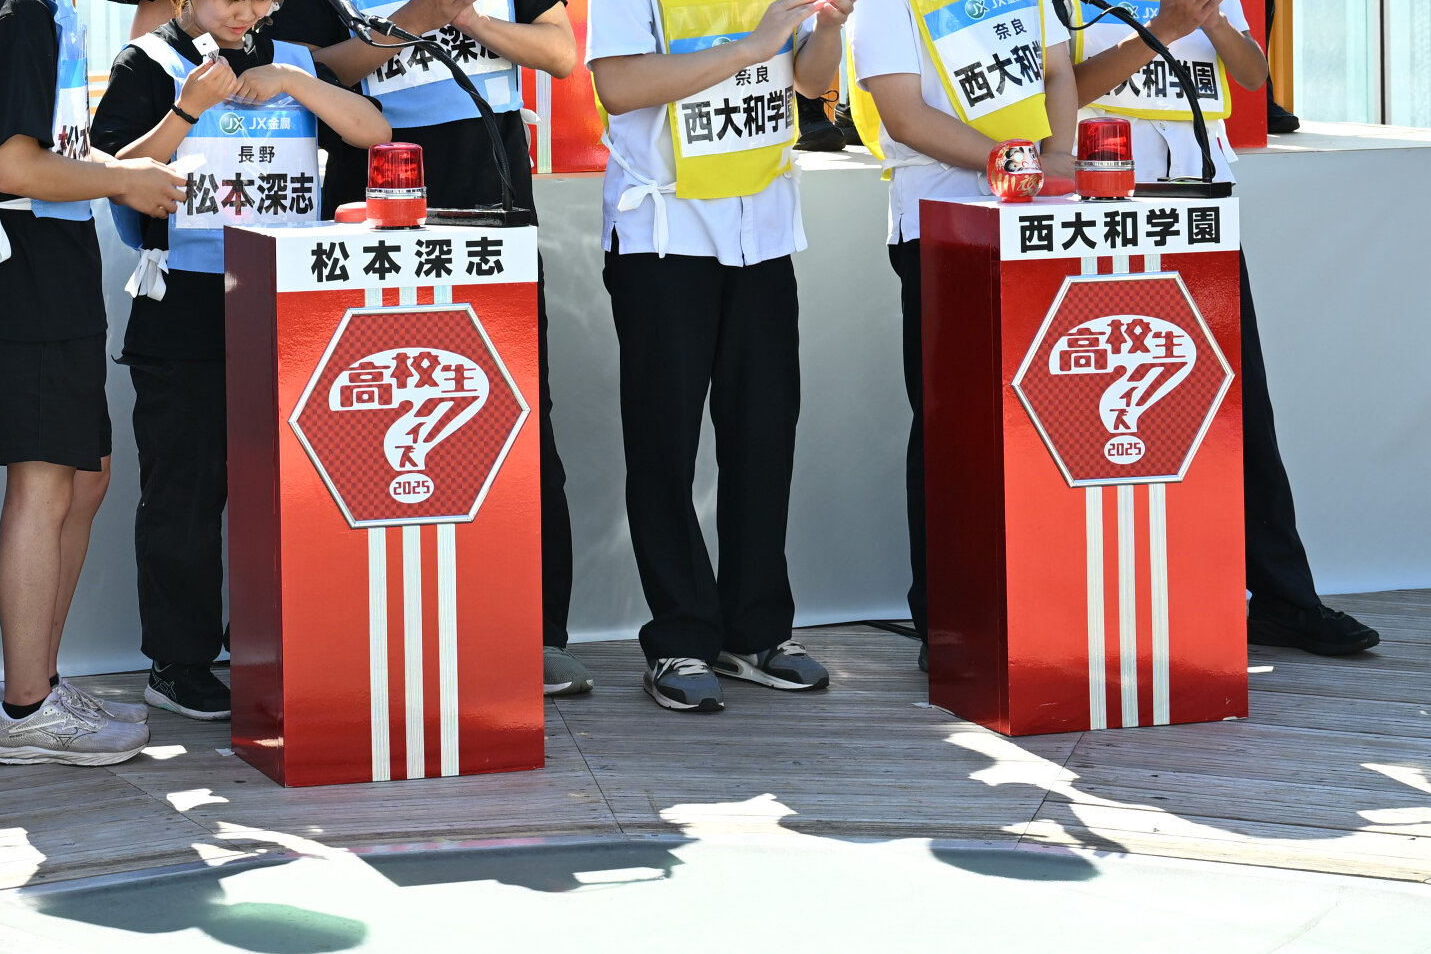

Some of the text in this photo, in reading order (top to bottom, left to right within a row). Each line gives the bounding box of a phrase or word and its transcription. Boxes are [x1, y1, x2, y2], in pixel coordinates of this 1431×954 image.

[992, 18, 1027, 40] 奈良
[734, 66, 769, 86] 奈良
[238, 145, 276, 164] 長野
[183, 172, 314, 216] 松本深志
[1018, 206, 1220, 253] 西大和学園
[310, 236, 504, 283] 松本深志
[1059, 318, 1186, 372] 高校生
[339, 351, 478, 408] 高校生
[1107, 442, 1142, 457] 2025
[393, 480, 431, 495] 2025
